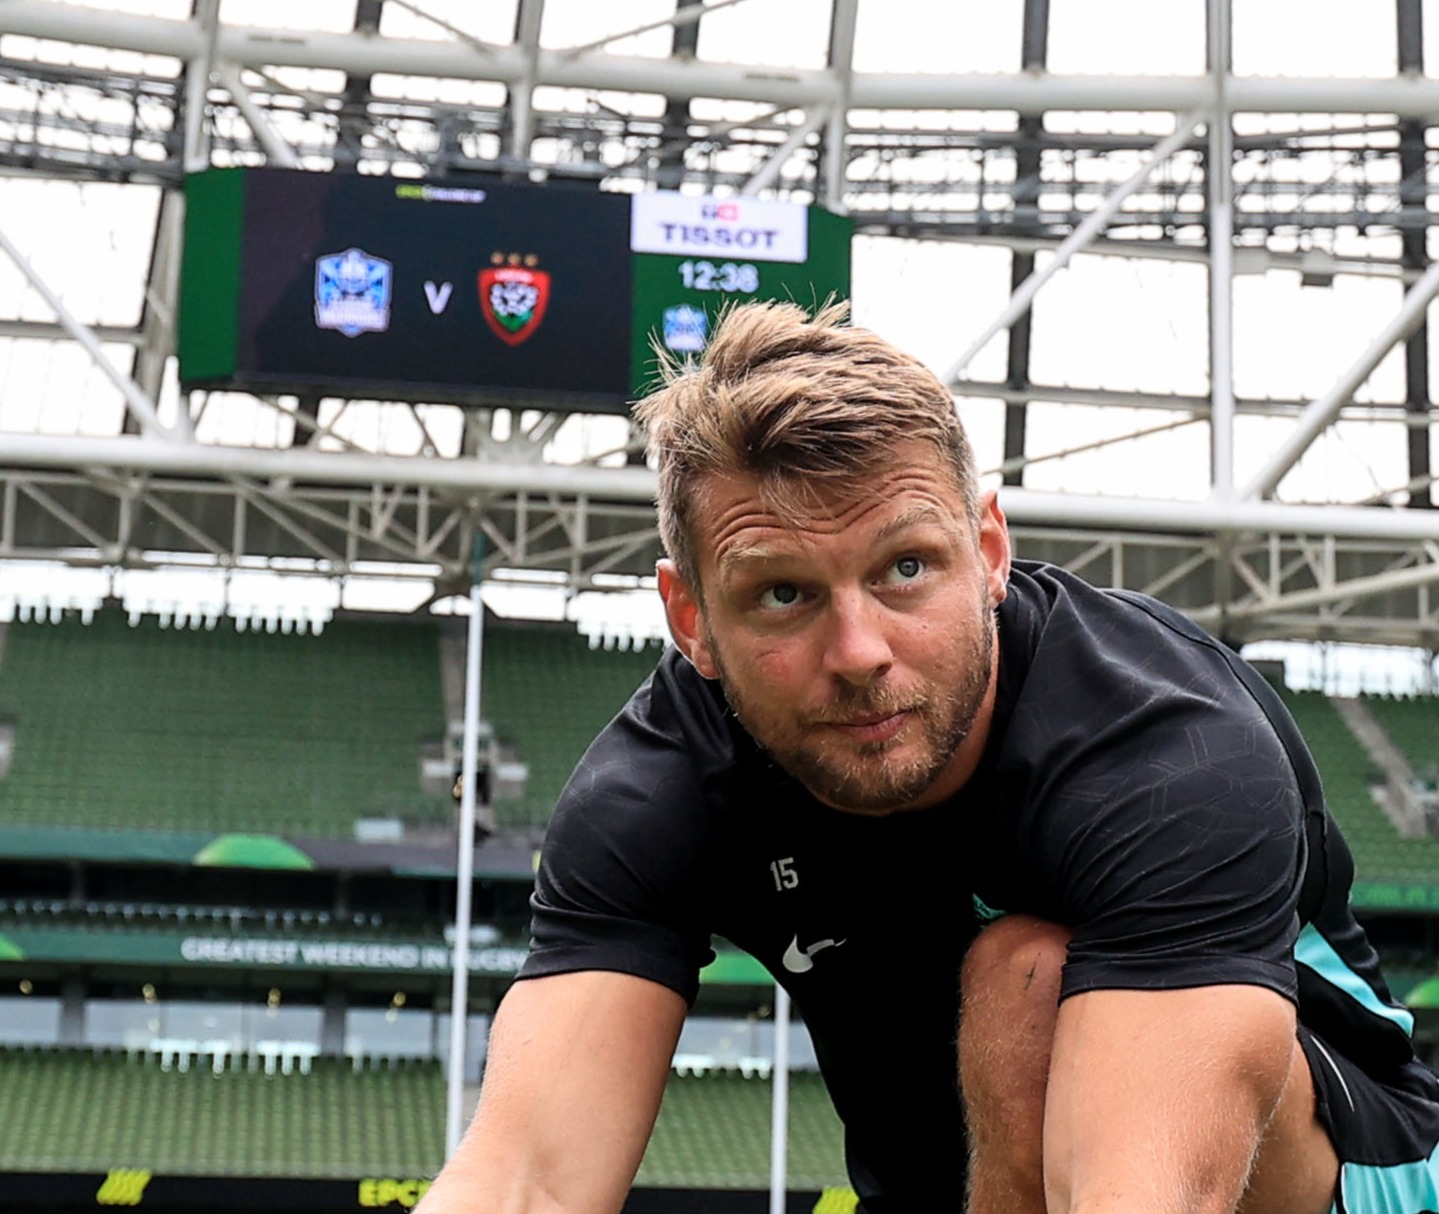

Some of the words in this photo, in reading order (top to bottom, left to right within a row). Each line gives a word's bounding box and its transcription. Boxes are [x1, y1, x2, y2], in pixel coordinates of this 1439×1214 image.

[660, 222, 777, 248] TISSOT
[678, 259, 760, 293] 12:38
[770, 857, 799, 891] 15
